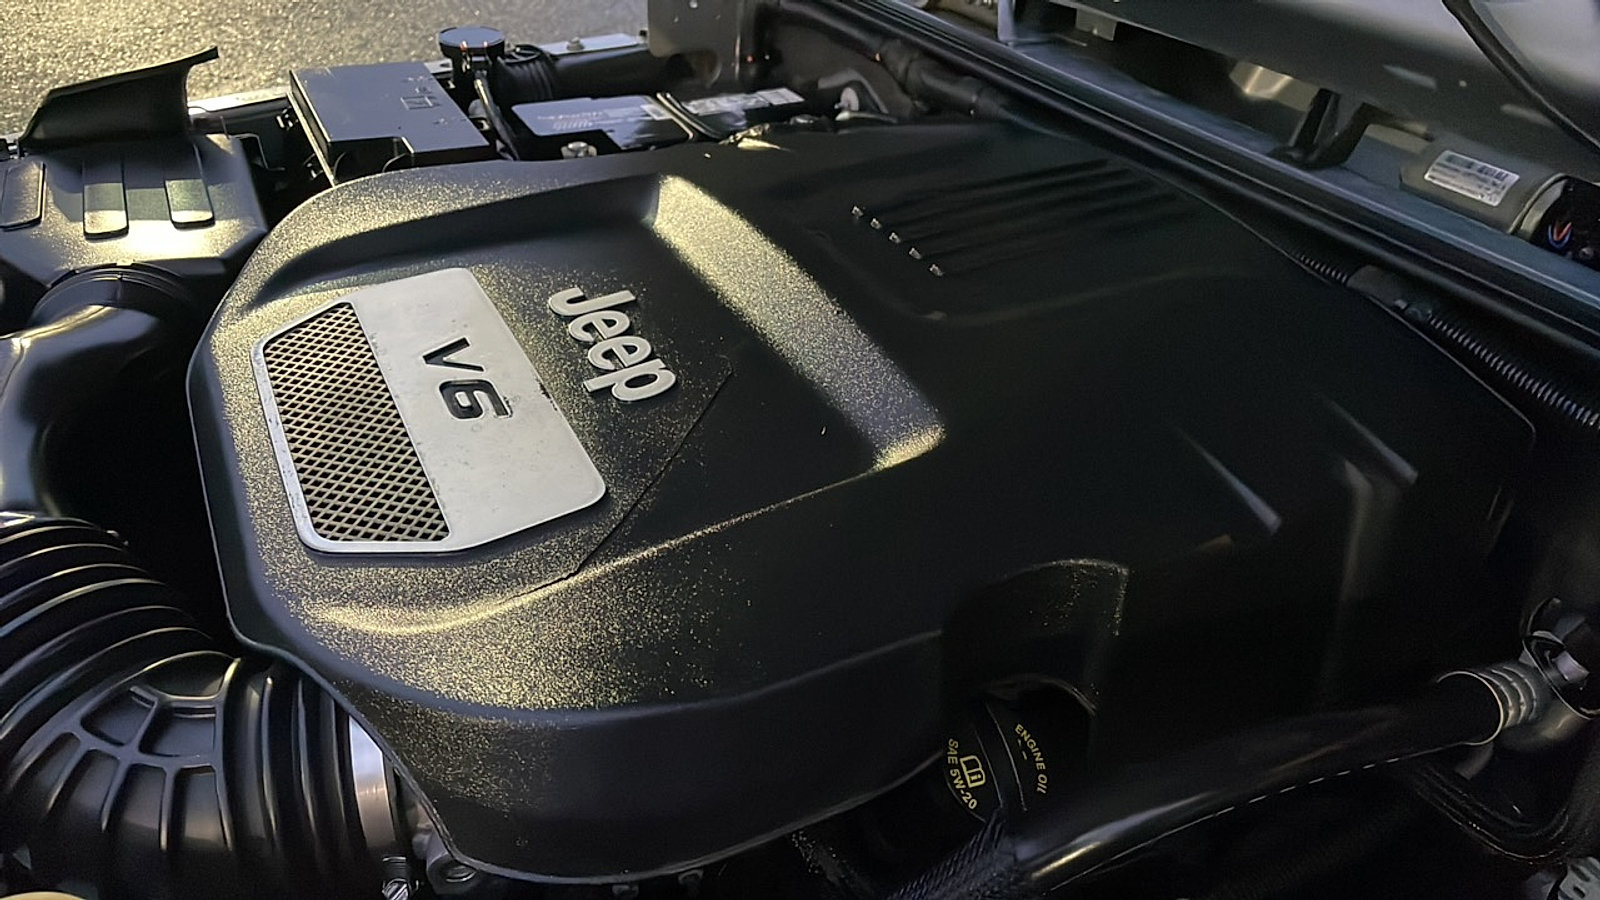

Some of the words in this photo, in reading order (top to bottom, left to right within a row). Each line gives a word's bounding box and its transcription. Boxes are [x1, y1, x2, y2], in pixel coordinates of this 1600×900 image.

[421, 337, 512, 420] V6
[549, 287, 677, 402] Jeep
[947, 738, 959, 765] SAE
[1015, 724, 1046, 770] ENGINE
[1036, 774, 1048, 794] OIL
[949, 768, 978, 810] 5W-20
